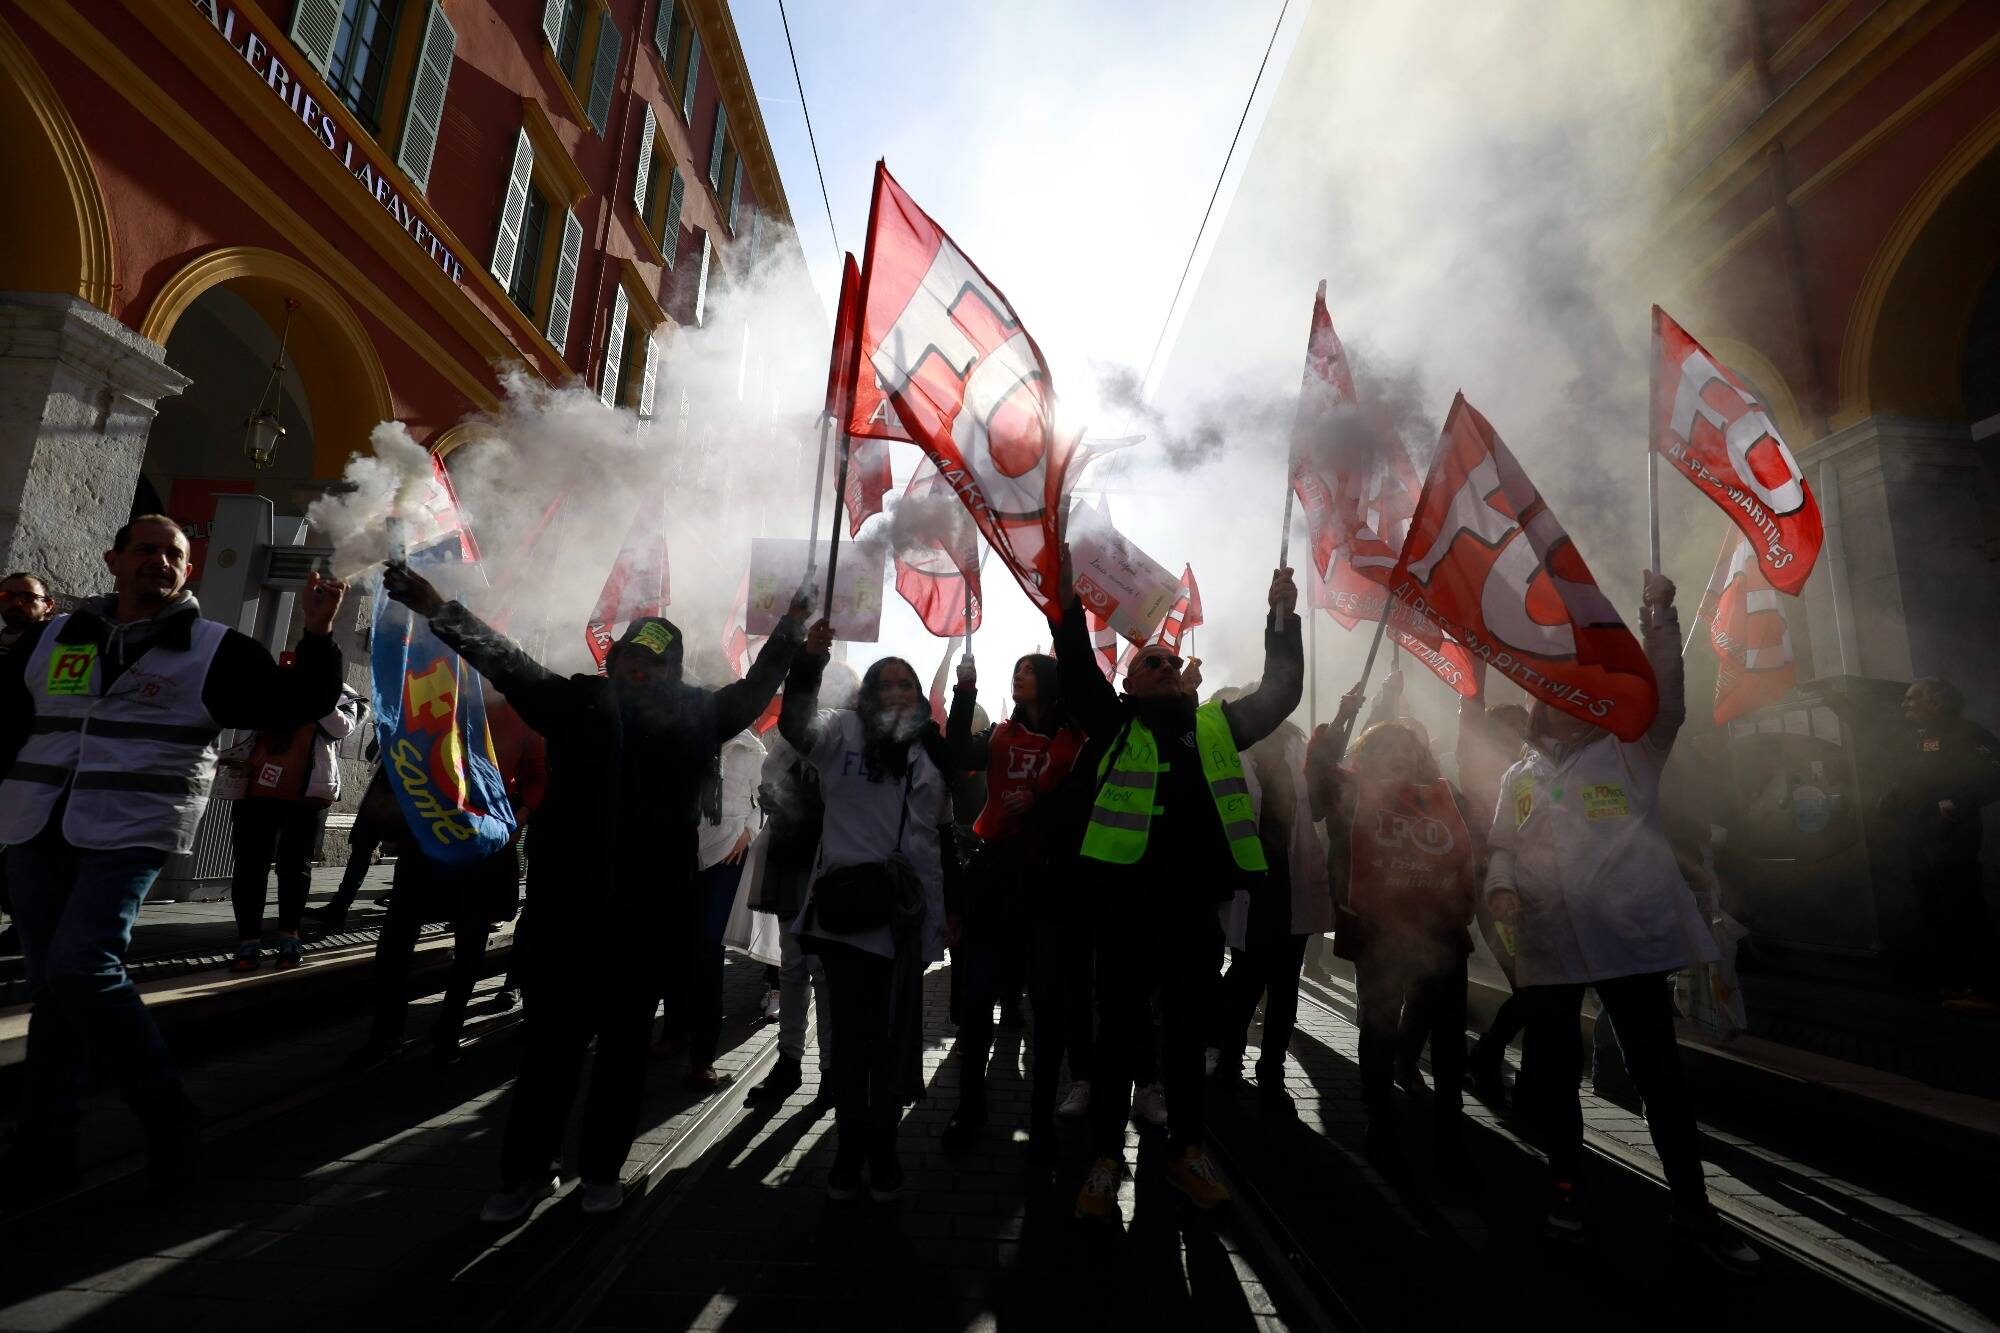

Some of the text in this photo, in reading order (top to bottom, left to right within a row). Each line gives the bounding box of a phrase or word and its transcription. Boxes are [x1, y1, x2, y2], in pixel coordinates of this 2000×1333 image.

[342, 142, 465, 290] LAFAYETTE
[870, 233, 1050, 525] FO
[1670, 349, 1805, 515] FO
[1407, 430, 1623, 662] FO
[54, 654, 90, 680] FO
[1375, 807, 1455, 856] FO
